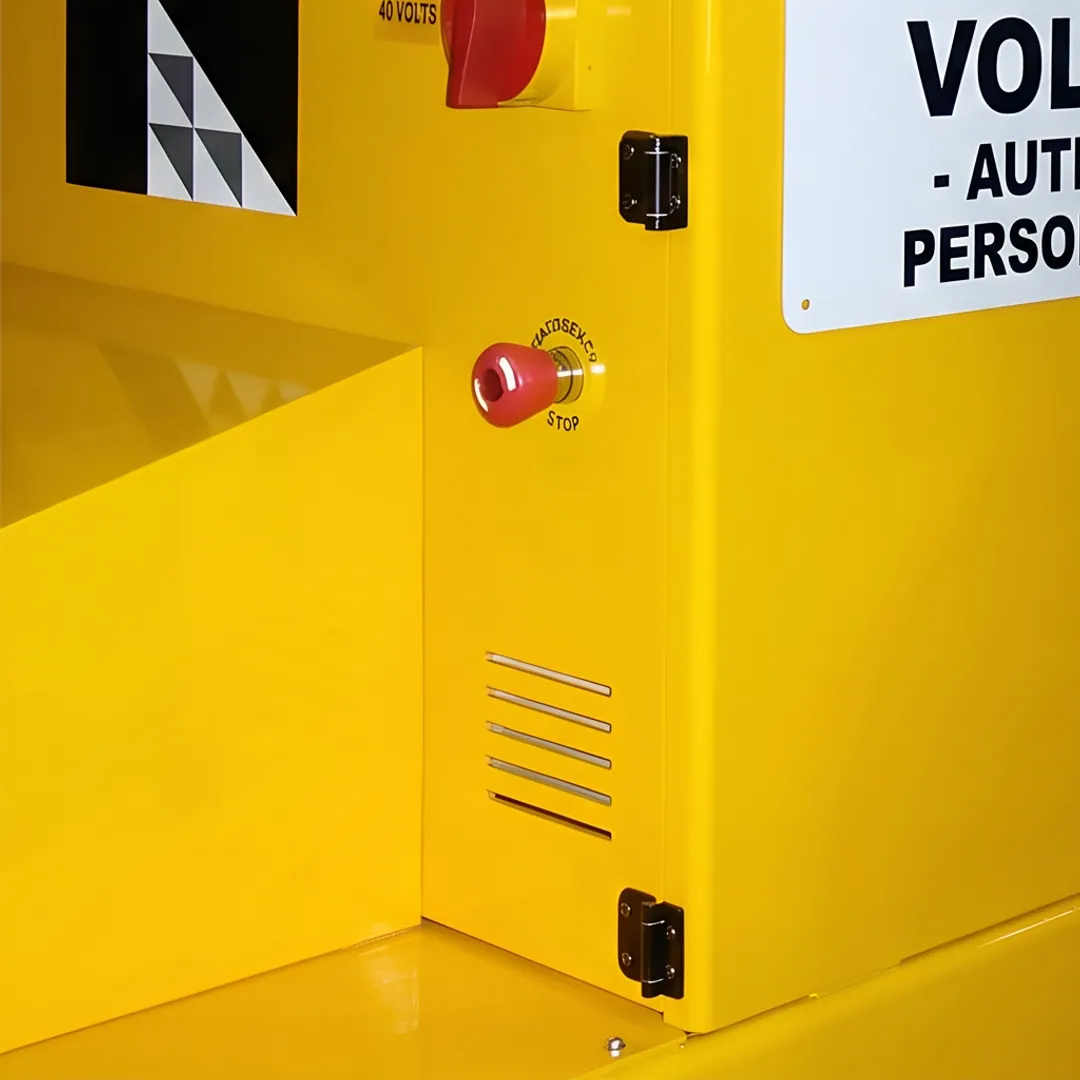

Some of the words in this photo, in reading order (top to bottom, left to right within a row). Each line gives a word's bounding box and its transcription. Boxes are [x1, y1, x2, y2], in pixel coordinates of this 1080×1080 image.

[378, 0, 394, 21] 40
[396, 1, 437, 24] VOLTS
[547, 410, 579, 431] STOP
